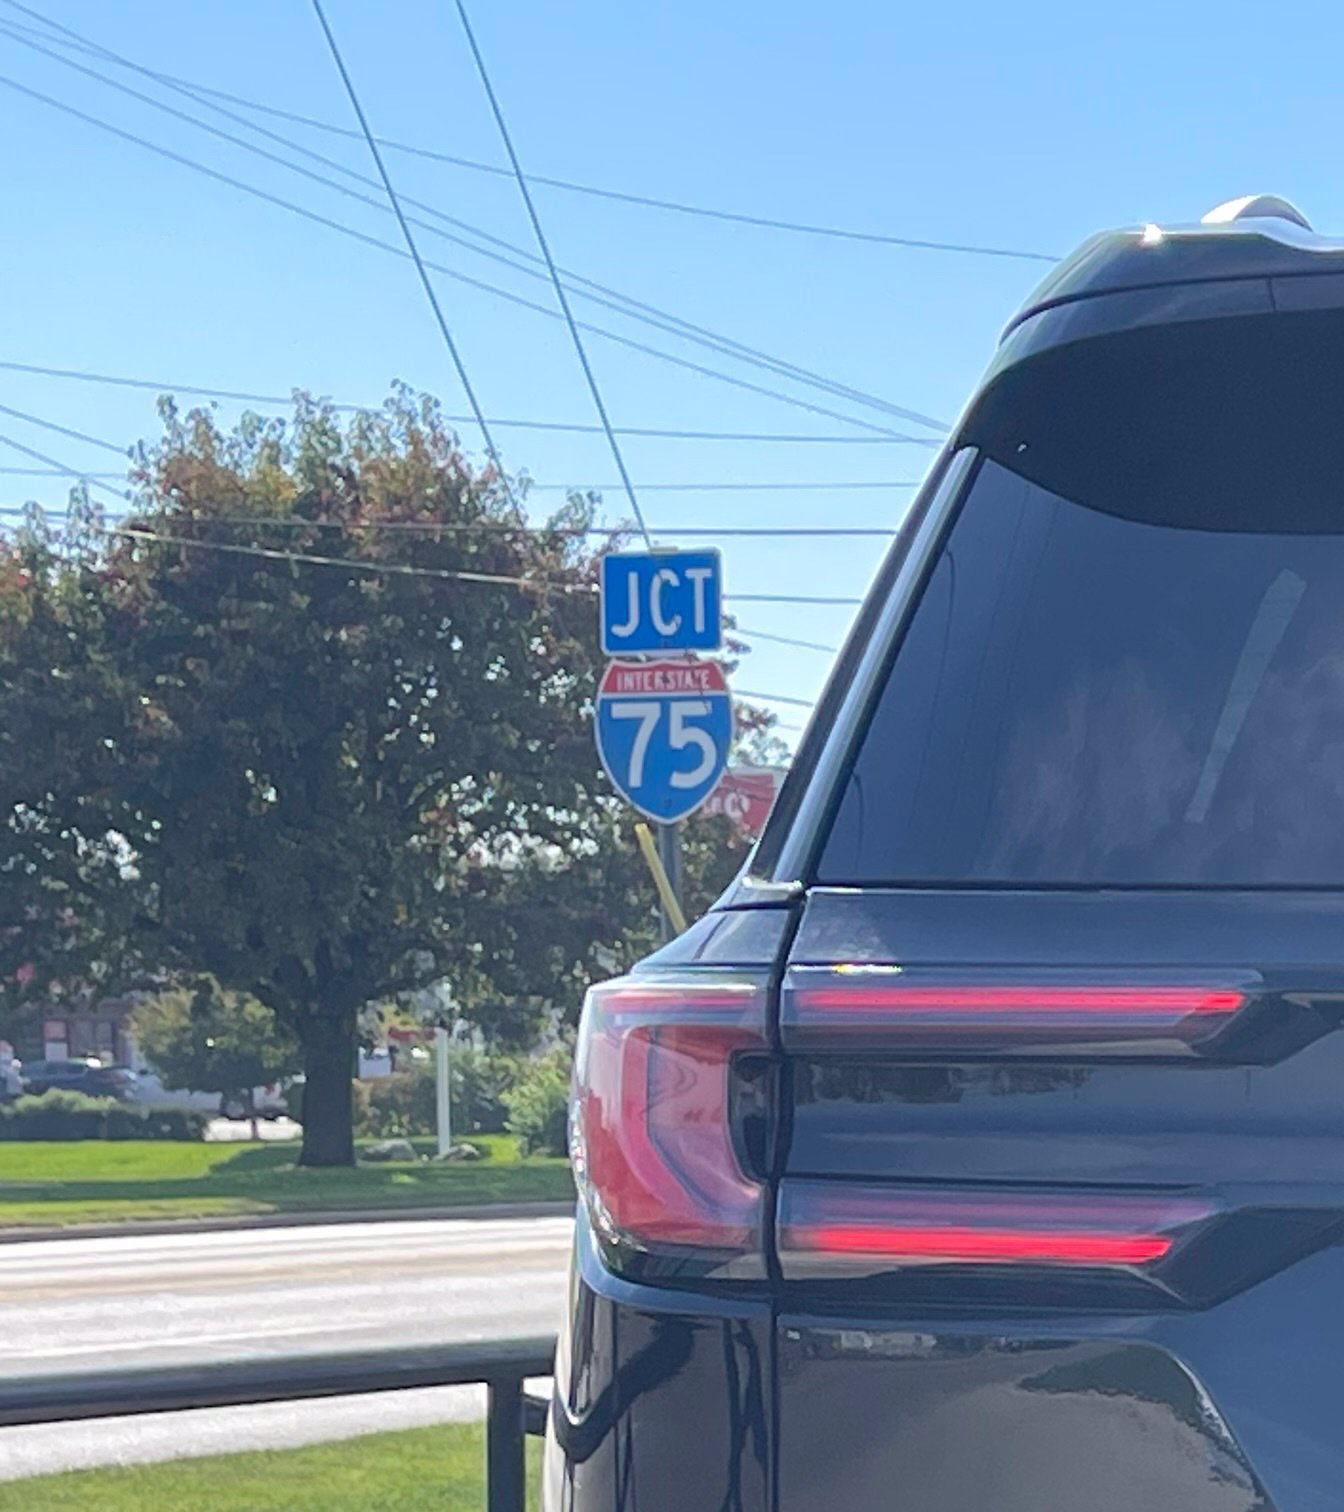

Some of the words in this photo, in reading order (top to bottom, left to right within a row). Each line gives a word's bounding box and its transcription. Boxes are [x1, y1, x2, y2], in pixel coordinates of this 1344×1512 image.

[610, 568, 713, 637] JCT
[617, 670, 709, 691] INTERSTATE
[610, 701, 717, 789] 75
